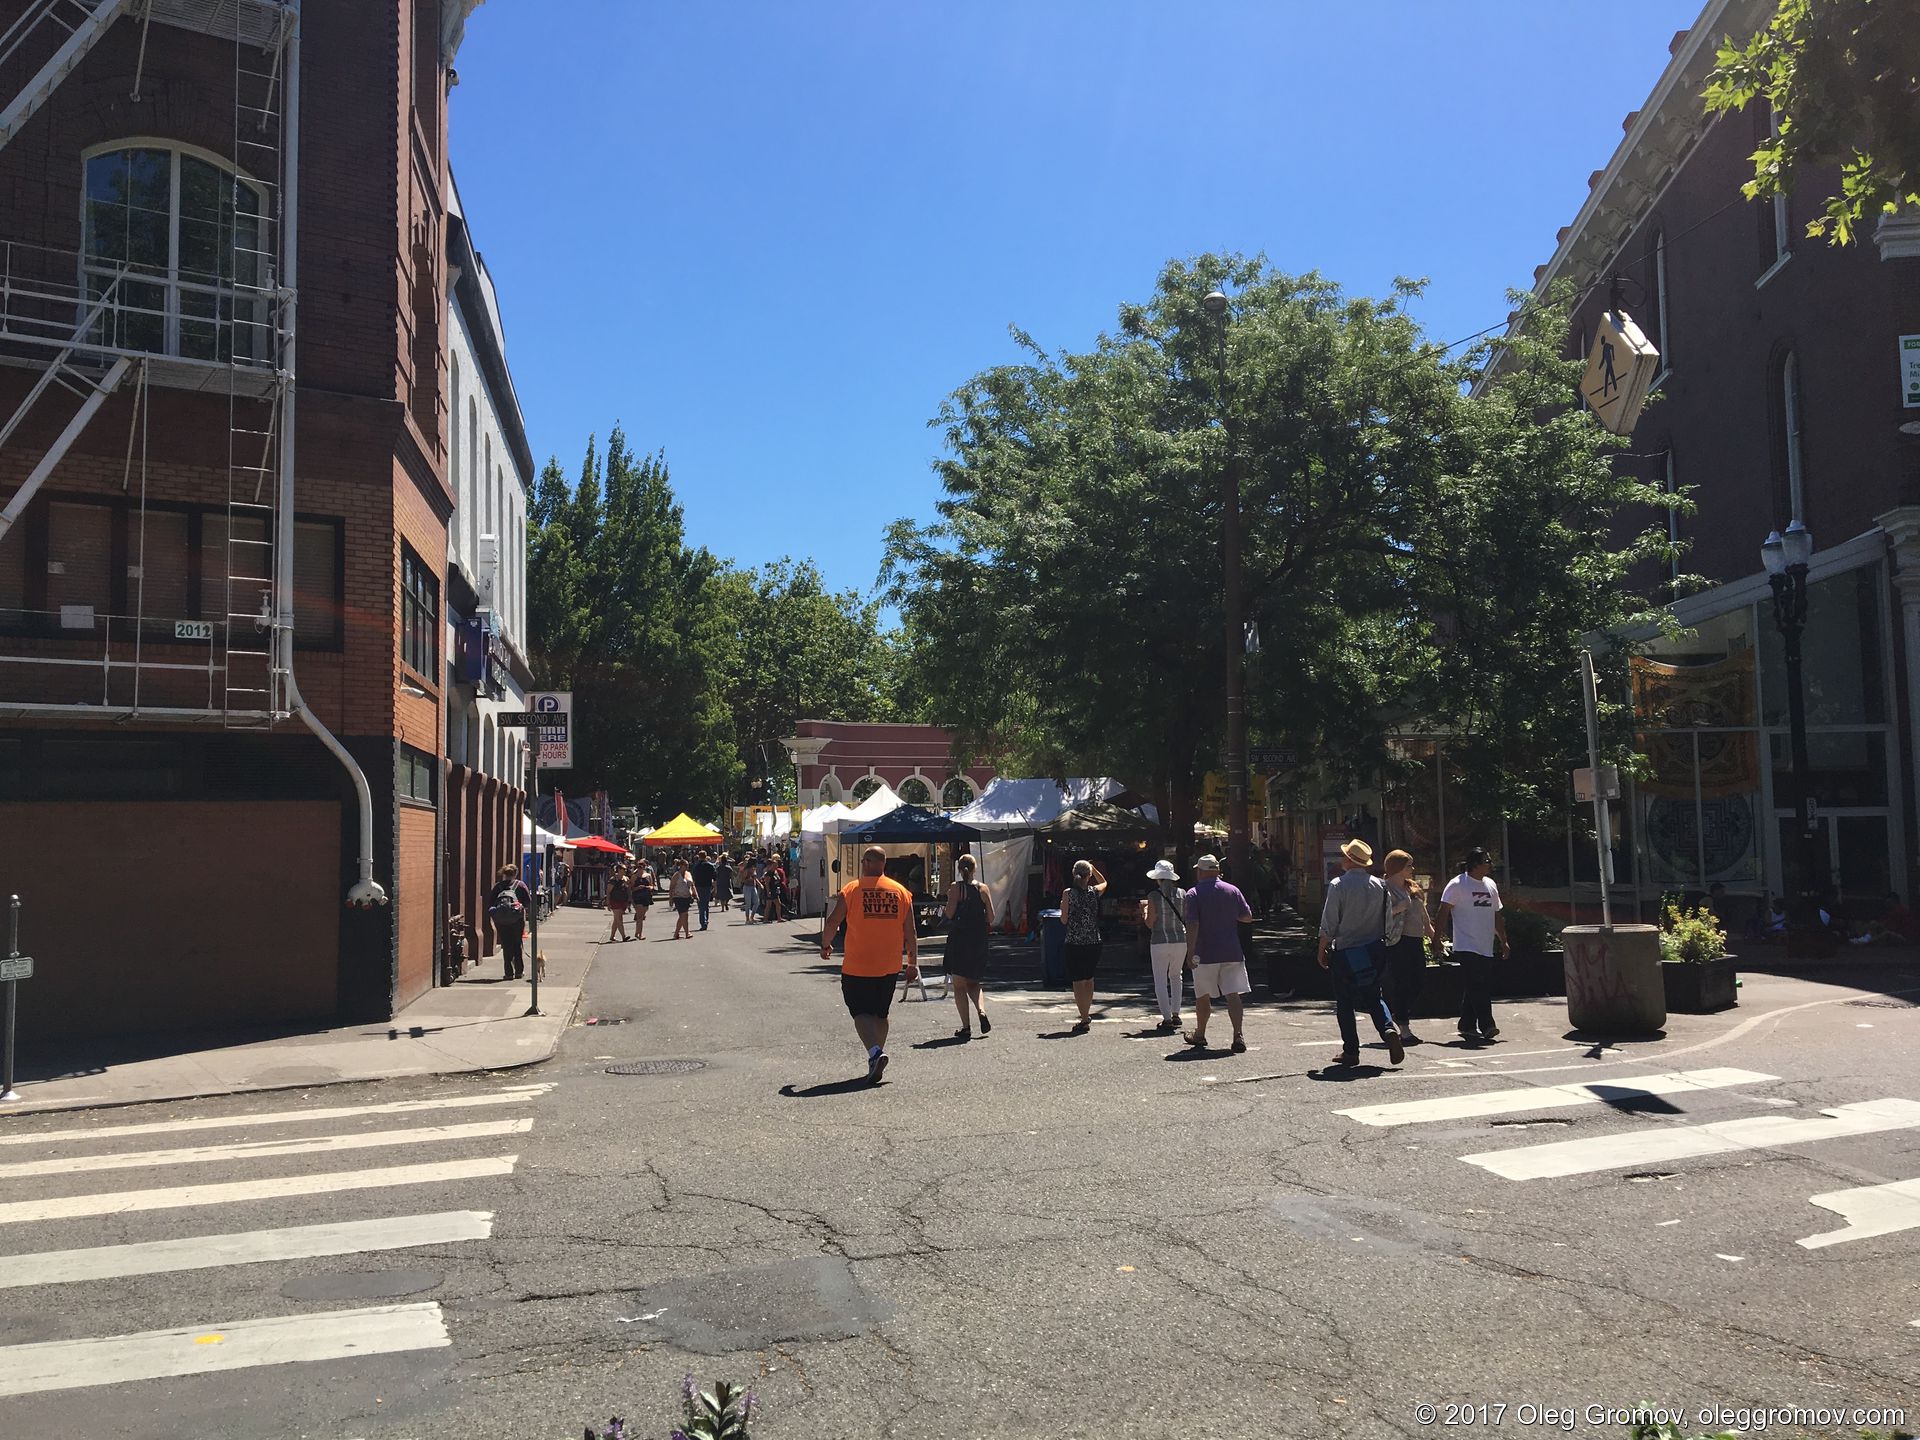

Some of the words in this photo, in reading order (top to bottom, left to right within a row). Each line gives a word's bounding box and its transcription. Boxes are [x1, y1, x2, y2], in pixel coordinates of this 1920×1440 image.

[501, 714, 513, 725] SW
[518, 714, 548, 725] SECOND
[553, 714, 566, 725] AVE
[550, 744, 569, 752] PARK
[863, 903, 899, 913] NUTS
